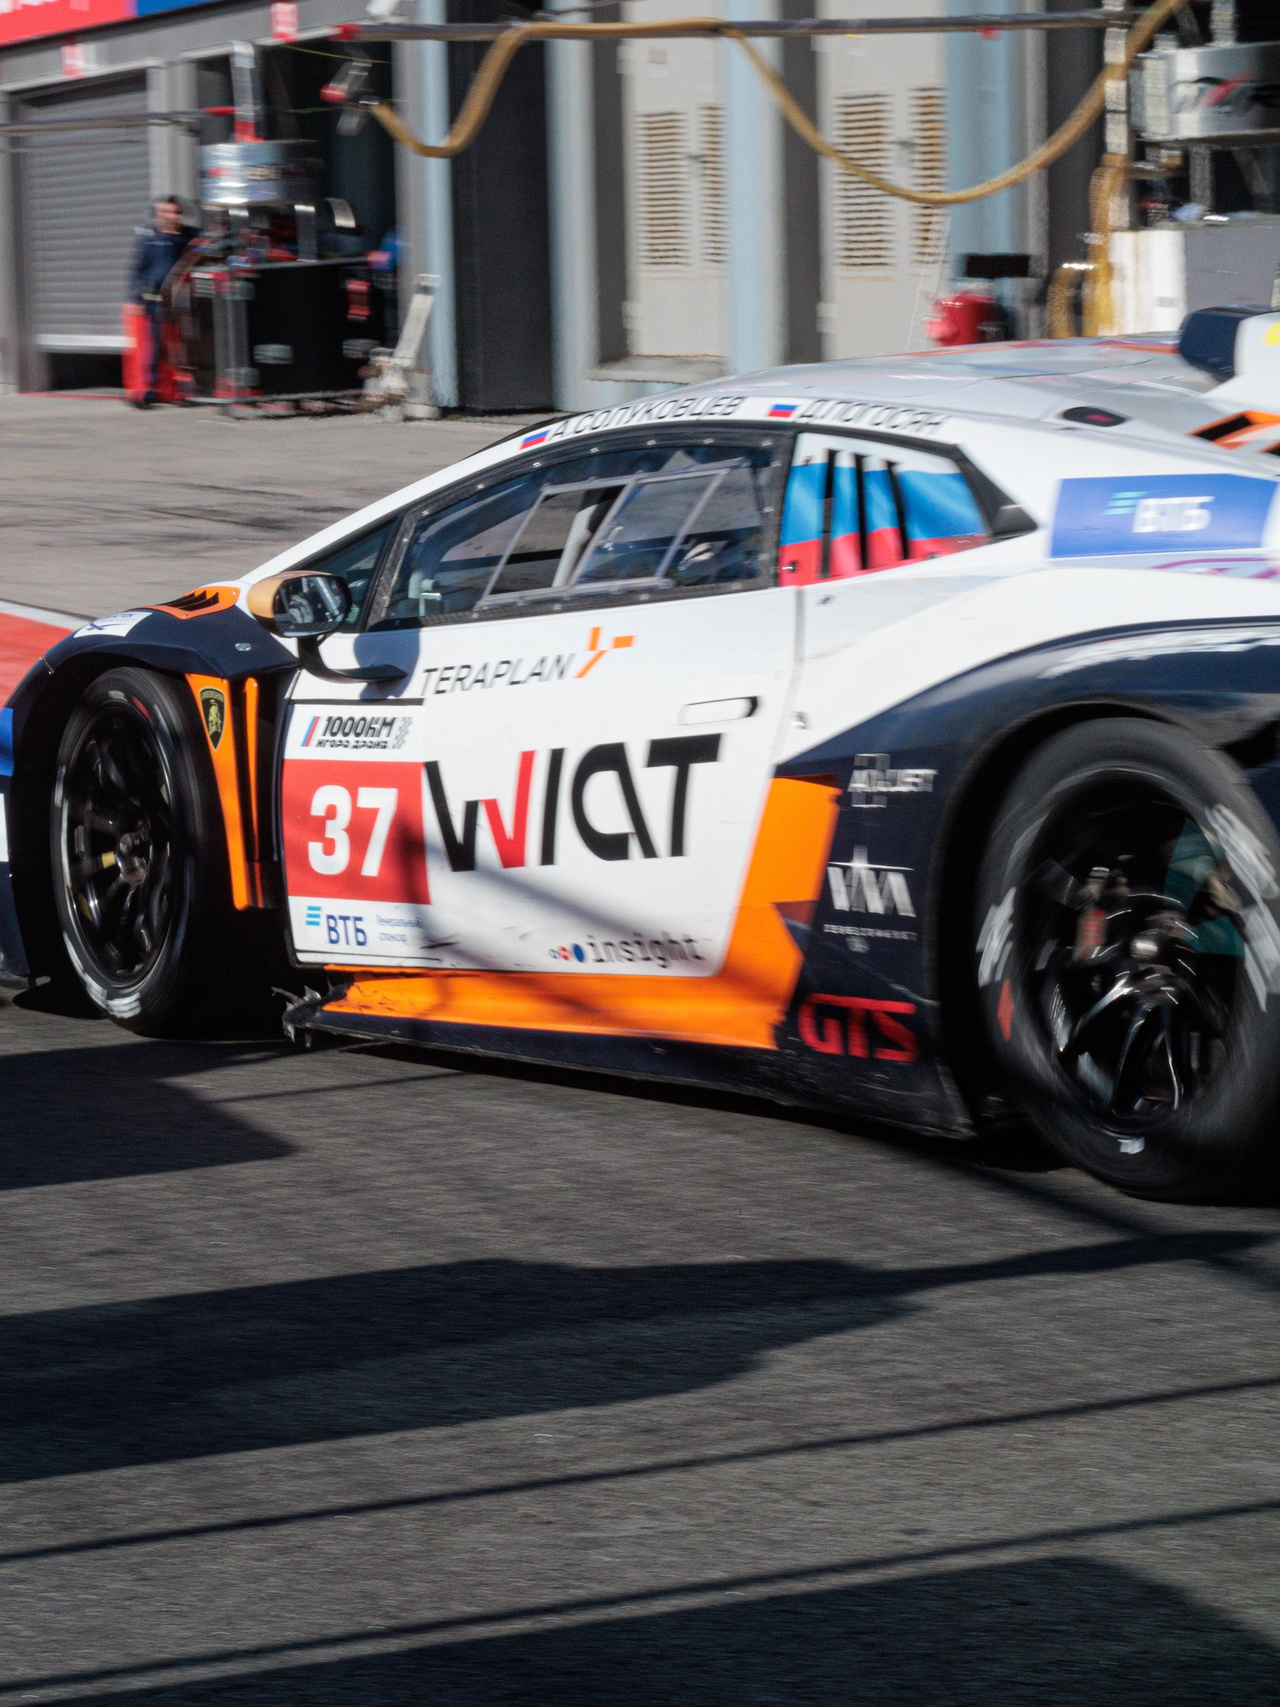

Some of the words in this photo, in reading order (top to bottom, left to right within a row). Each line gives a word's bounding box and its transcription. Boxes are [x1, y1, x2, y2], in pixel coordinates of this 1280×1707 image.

[421, 652, 577, 697] TERAPLAN
[307, 784, 399, 878] 37
[326, 913, 368, 947] ВТБ
[586, 930, 705, 969] insight
[797, 993, 918, 1063] GTS
